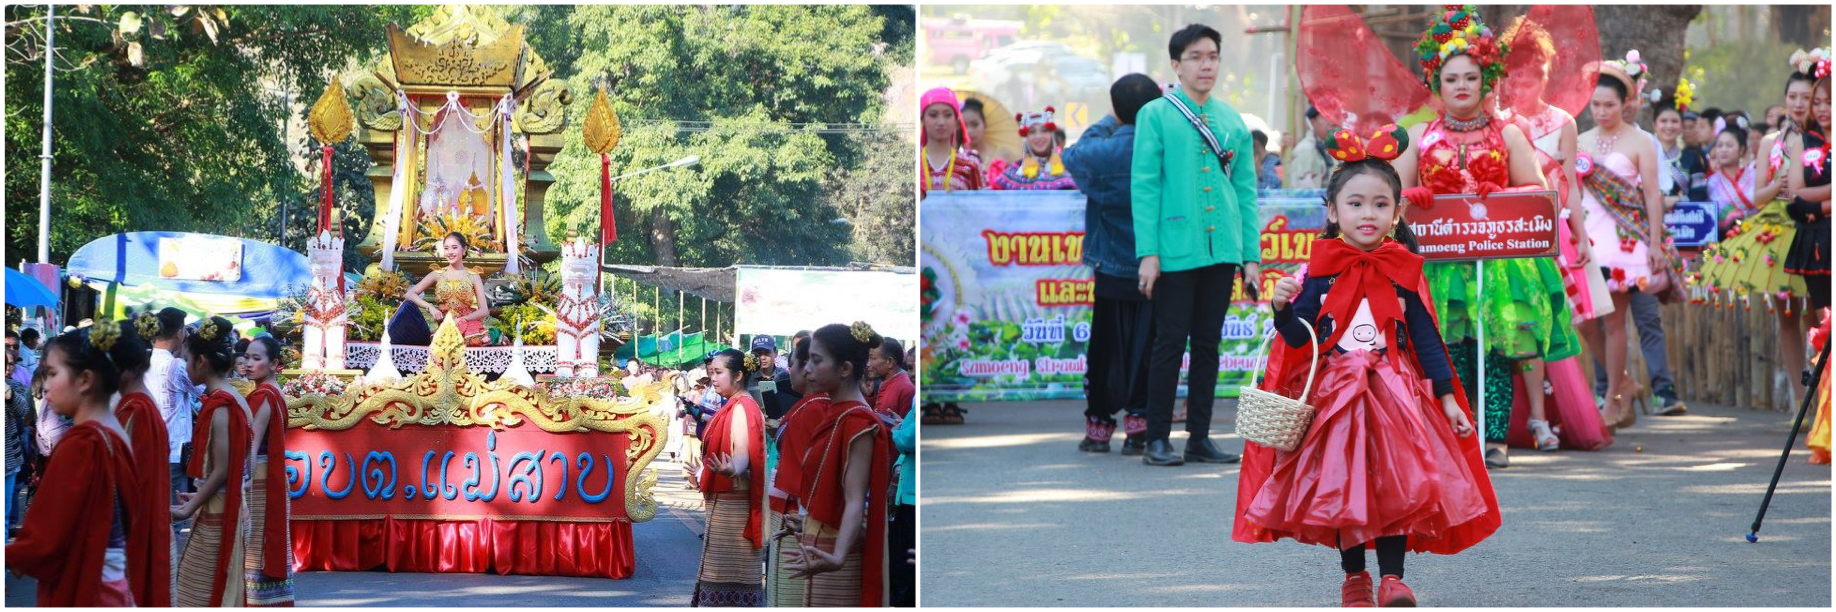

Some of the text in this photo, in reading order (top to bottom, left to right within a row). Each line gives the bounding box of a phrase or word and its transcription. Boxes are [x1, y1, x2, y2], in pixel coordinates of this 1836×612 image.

[1418, 238, 1549, 254] amoeng Police Station
